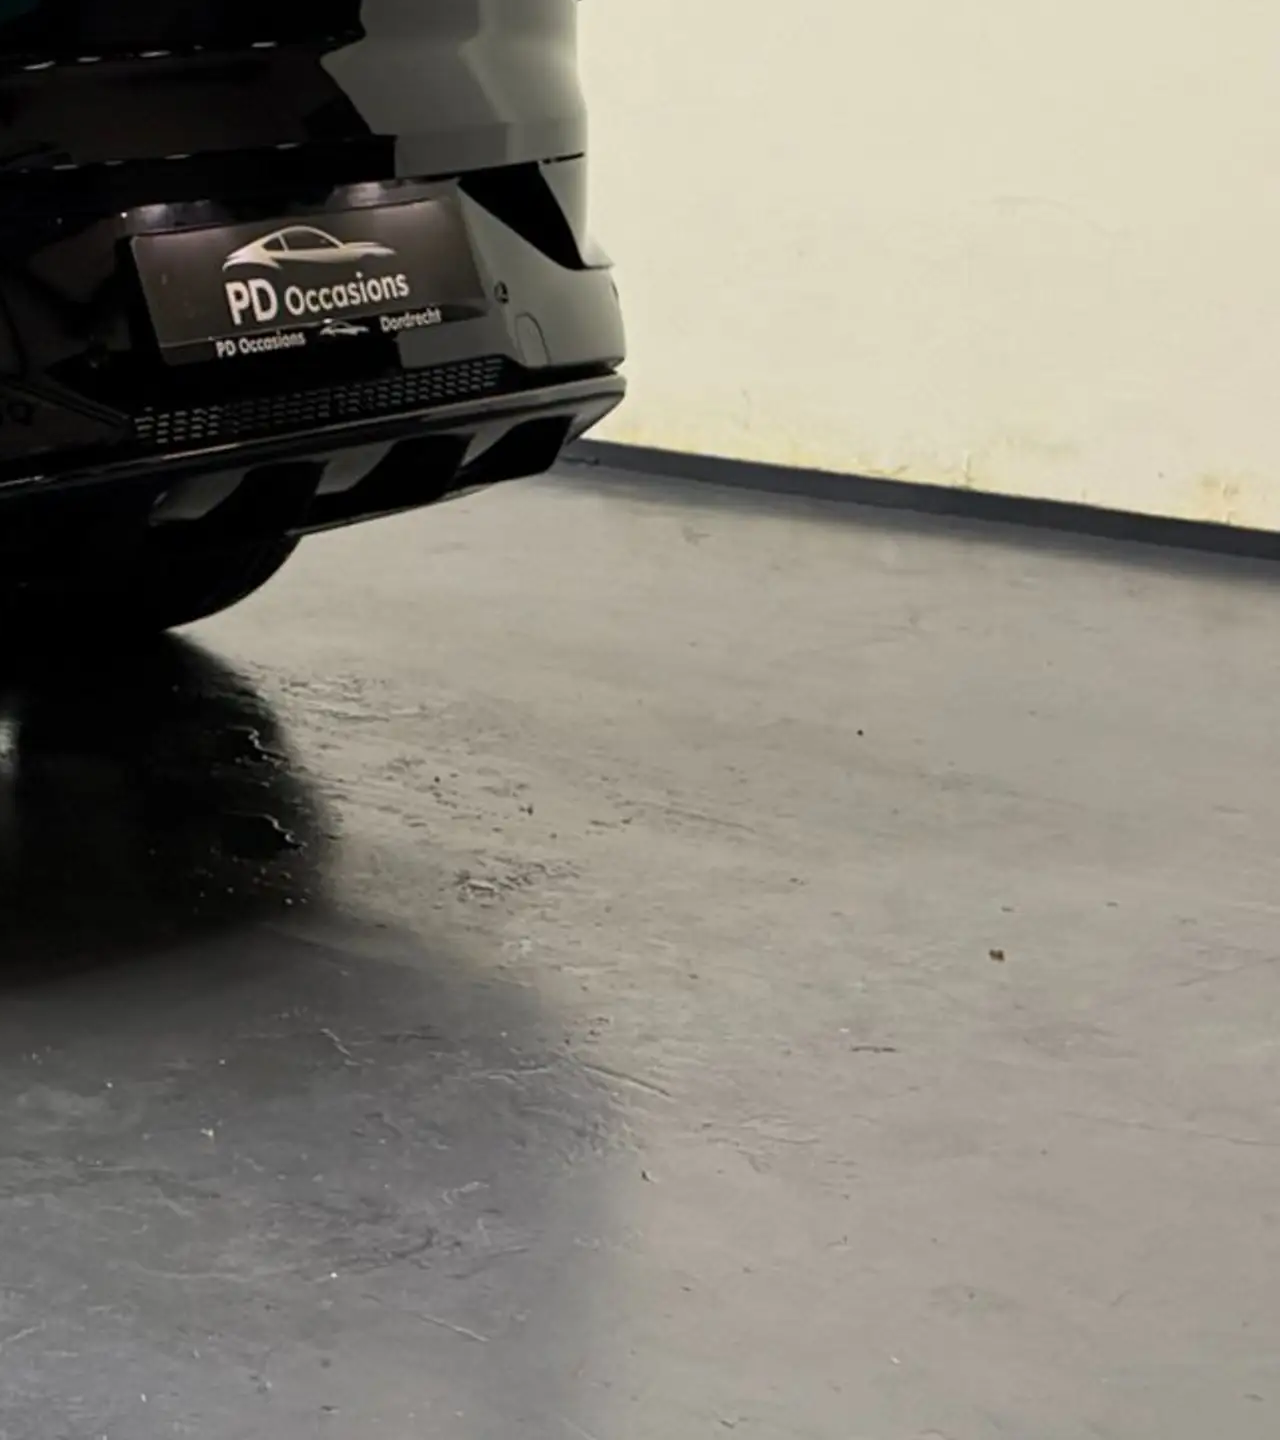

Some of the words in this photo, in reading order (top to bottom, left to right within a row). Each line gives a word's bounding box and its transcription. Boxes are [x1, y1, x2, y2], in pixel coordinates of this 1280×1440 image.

[225, 278, 278, 325] PD
[284, 272, 409, 315] Occasions
[216, 340, 237, 358] PD
[240, 330, 306, 353] Occasions
[379, 307, 442, 332] Dordrecht
